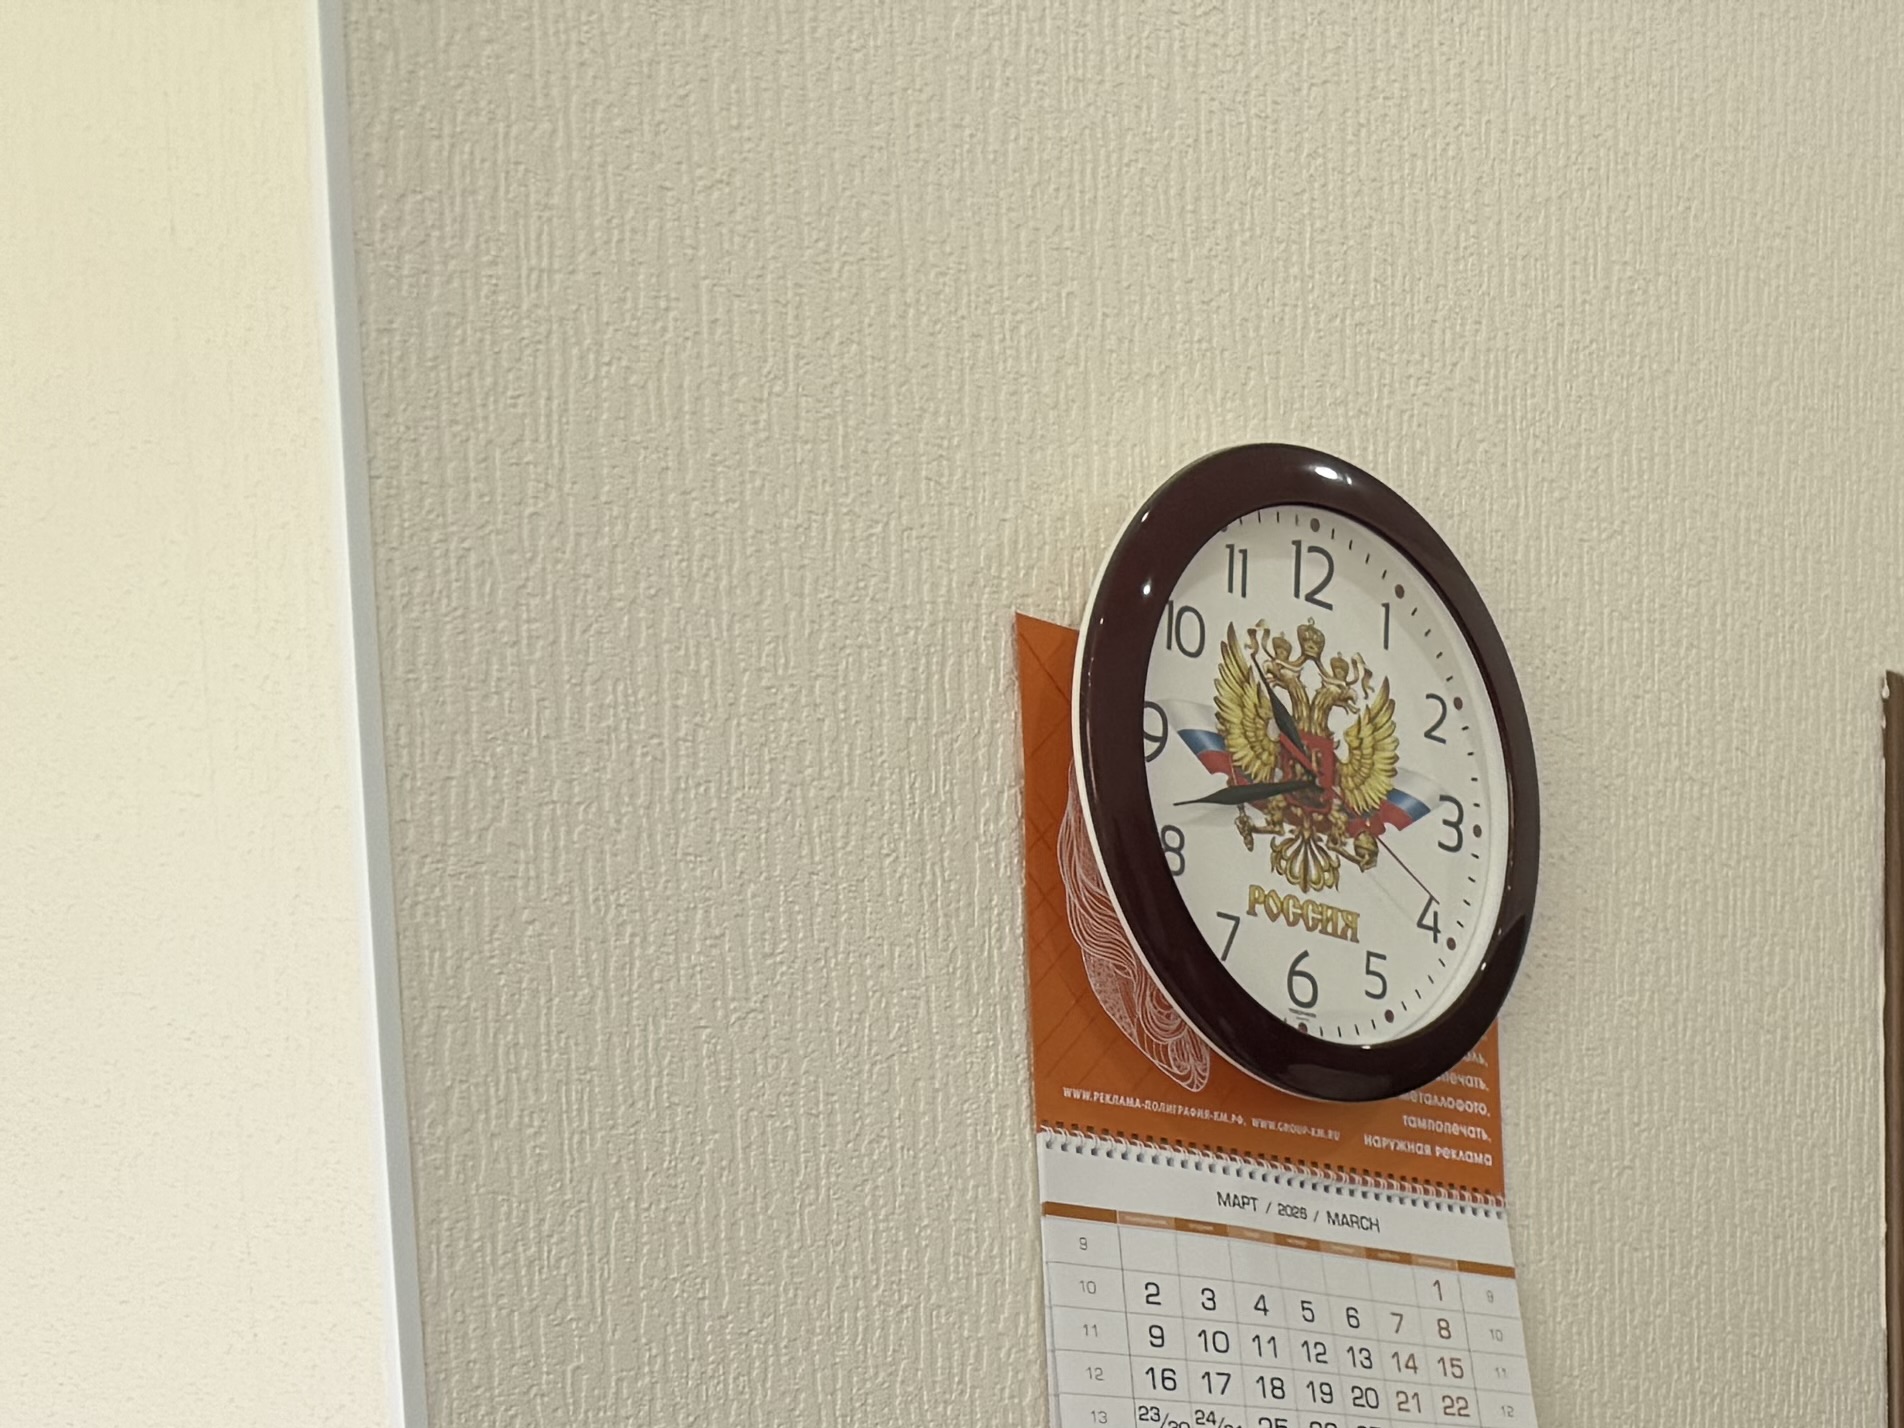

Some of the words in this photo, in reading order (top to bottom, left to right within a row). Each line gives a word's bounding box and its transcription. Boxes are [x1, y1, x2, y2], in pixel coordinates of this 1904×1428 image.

[1226, 543, 1247, 599] 11
[1292, 539, 1335, 611] 12
[1164, 599, 1206, 659] 10
[1381, 602, 1391, 650] 1
[1144, 700, 1169, 763] 9
[1424, 692, 1448, 744] 2
[1437, 795, 1465, 853] 3
[1161, 825, 1186, 877] 8
[1215, 911, 1241, 963] 7
[1245, 883, 1361, 944] РОССИЯ
[1415, 901, 1442, 944] 4
[1286, 948, 1319, 1010] 6
[1362, 952, 1388, 1001] 5
[1363, 1133, 1432, 1156] наружная
[1435, 1145, 1493, 1166] реклама
[1216, 1191, 1258, 1212] МАРТ
[1326, 1210, 1381, 1233] MARCH
[1144, 1281, 1162, 1306] 2
[1200, 1287, 1217, 1311] 3
[1253, 1294, 1269, 1316] 4
[1300, 1299, 1316, 1323] 5
[1345, 1306, 1361, 1329] 6
[1390, 1311, 1404, 1334] 7
[1436, 1317, 1452, 1340] 8
[1432, 1279, 1443, 1302] 1
[1148, 1324, 1165, 1348] 9
[1197, 1329, 1230, 1354] 10
[1251, 1334, 1278, 1359] 11
[1301, 1340, 1329, 1365] 12
[1346, 1345, 1373, 1370] 13
[1391, 1351, 1419, 1375] 14
[1437, 1356, 1465, 1380] 15
[1145, 1366, 1177, 1392] 16
[1201, 1371, 1232, 1396] 17
[1255, 1375, 1286, 1400] 18
[1306, 1380, 1334, 1405] 19
[1350, 1385, 1380, 1410] 20
[1395, 1390, 1422, 1414] 21
[1441, 1394, 1471, 1418] 22
